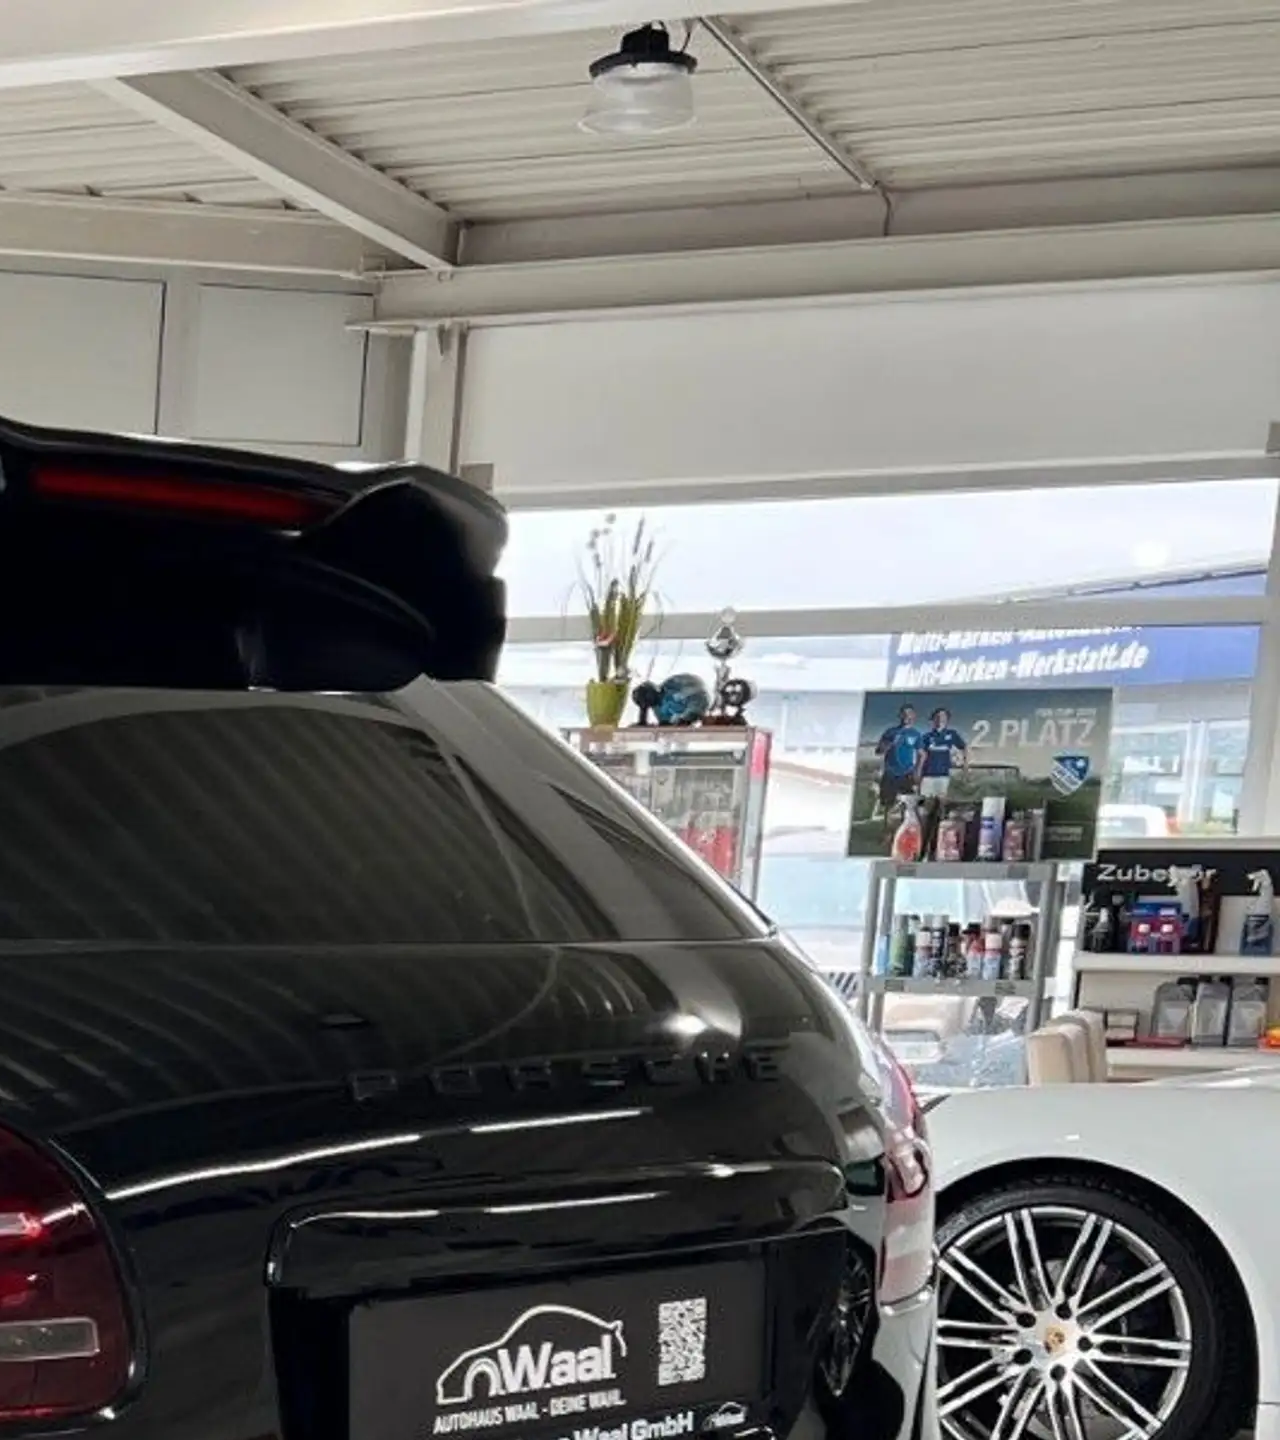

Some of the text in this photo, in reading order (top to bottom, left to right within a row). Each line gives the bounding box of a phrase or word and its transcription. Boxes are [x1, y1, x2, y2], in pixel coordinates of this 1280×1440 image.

[998, 718, 1096, 747] PLATZ
[350, 1051, 779, 1100] PORSCHE
[496, 1334, 616, 1394] Waal
[432, 1406, 504, 1435] AUTOHAUS
